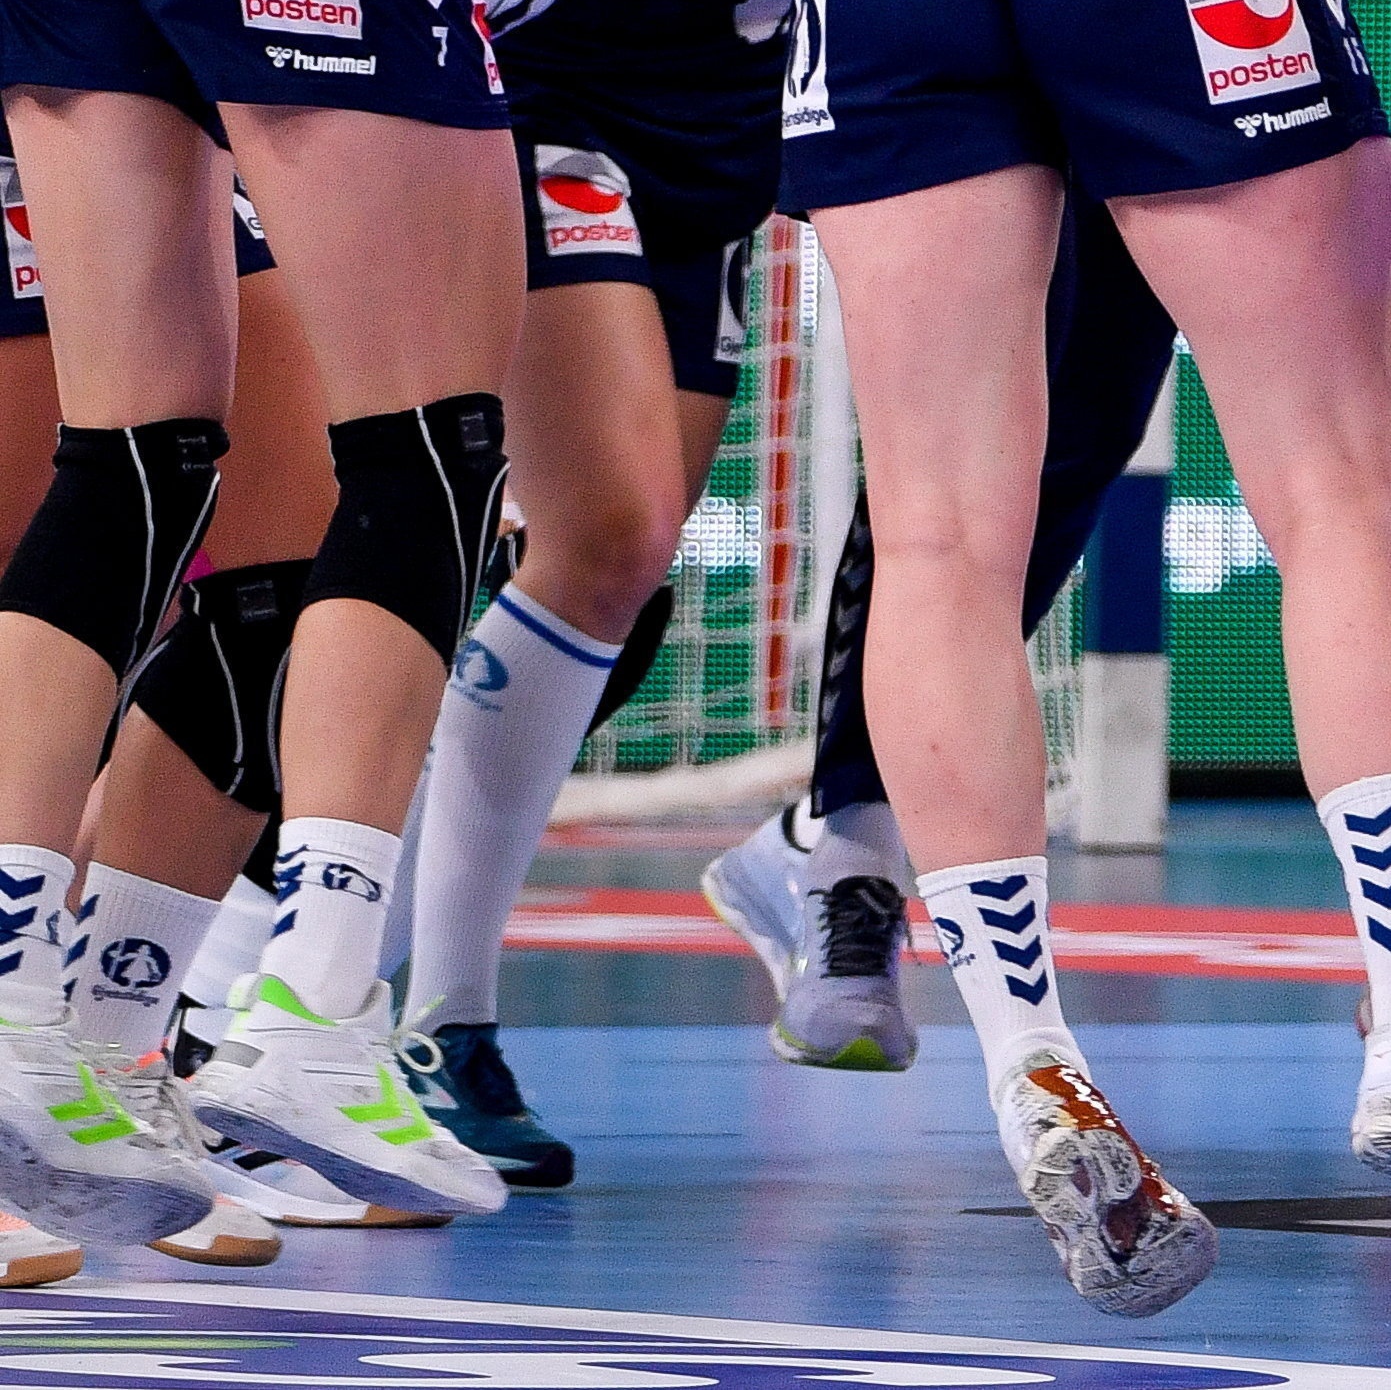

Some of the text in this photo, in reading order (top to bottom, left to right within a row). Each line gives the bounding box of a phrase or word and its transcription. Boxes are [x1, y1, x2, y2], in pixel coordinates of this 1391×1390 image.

[313, 49, 376, 76] hummel
[431, 26, 449, 67] 7
[1209, 51, 1314, 96] posten
[1263, 96, 1332, 133] hummel
